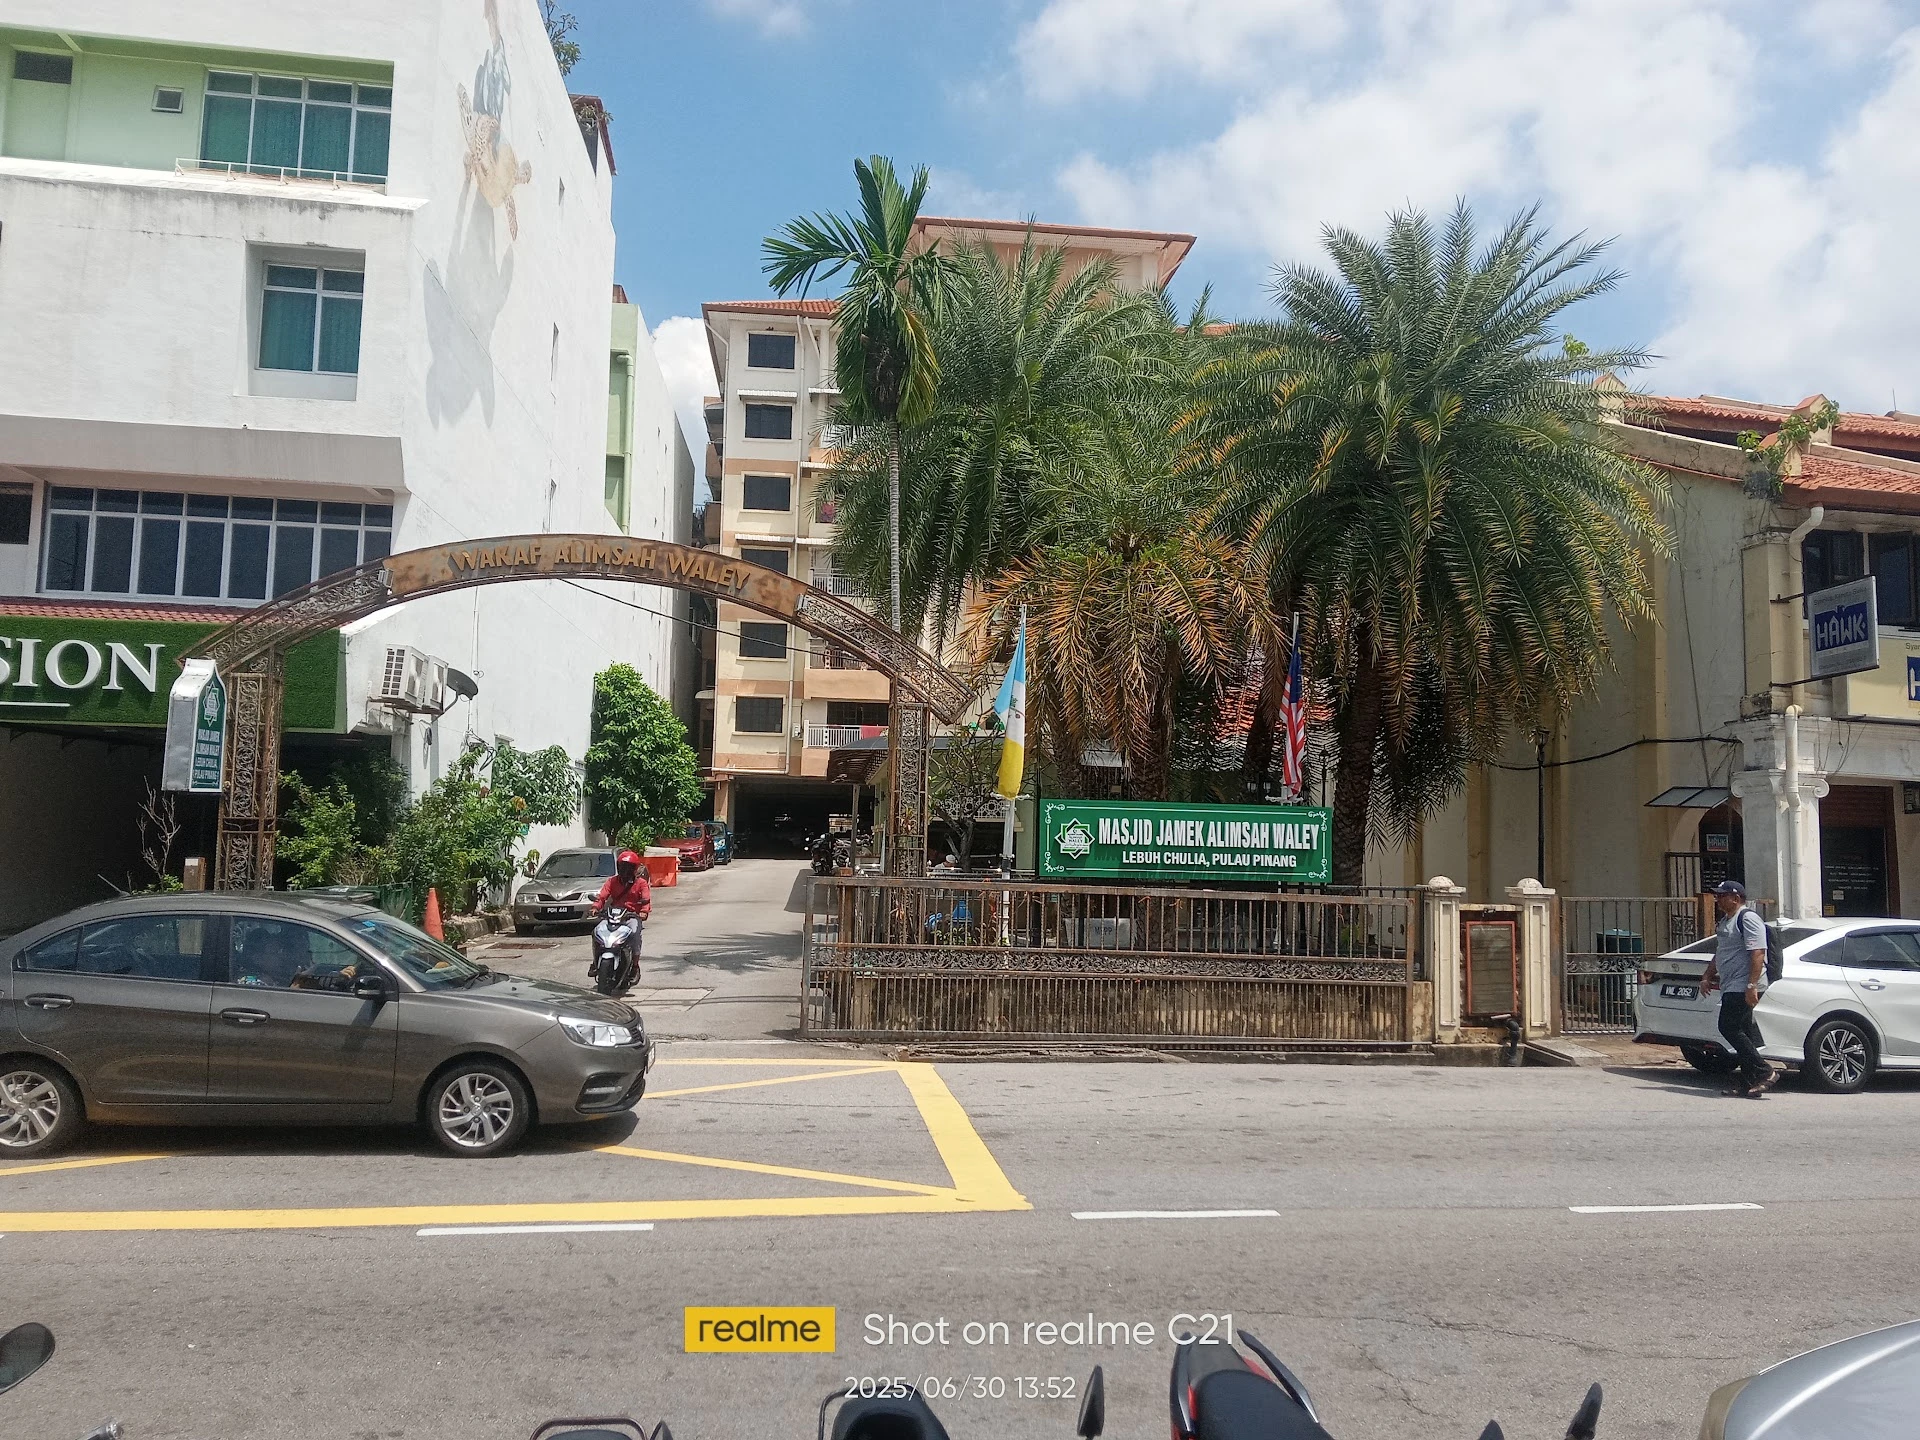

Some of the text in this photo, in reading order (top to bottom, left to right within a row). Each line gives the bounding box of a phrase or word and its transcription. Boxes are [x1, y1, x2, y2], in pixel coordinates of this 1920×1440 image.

[452, 544, 750, 590] WAKAF ALIMSAH WALEY
[1816, 613, 1866, 650] HAWK
[1098, 818, 1319, 850] MASJID JAMEK ALIMSAH WALEY
[1122, 850, 1297, 867] LEBUH CHULIA, PULAU PINANG
